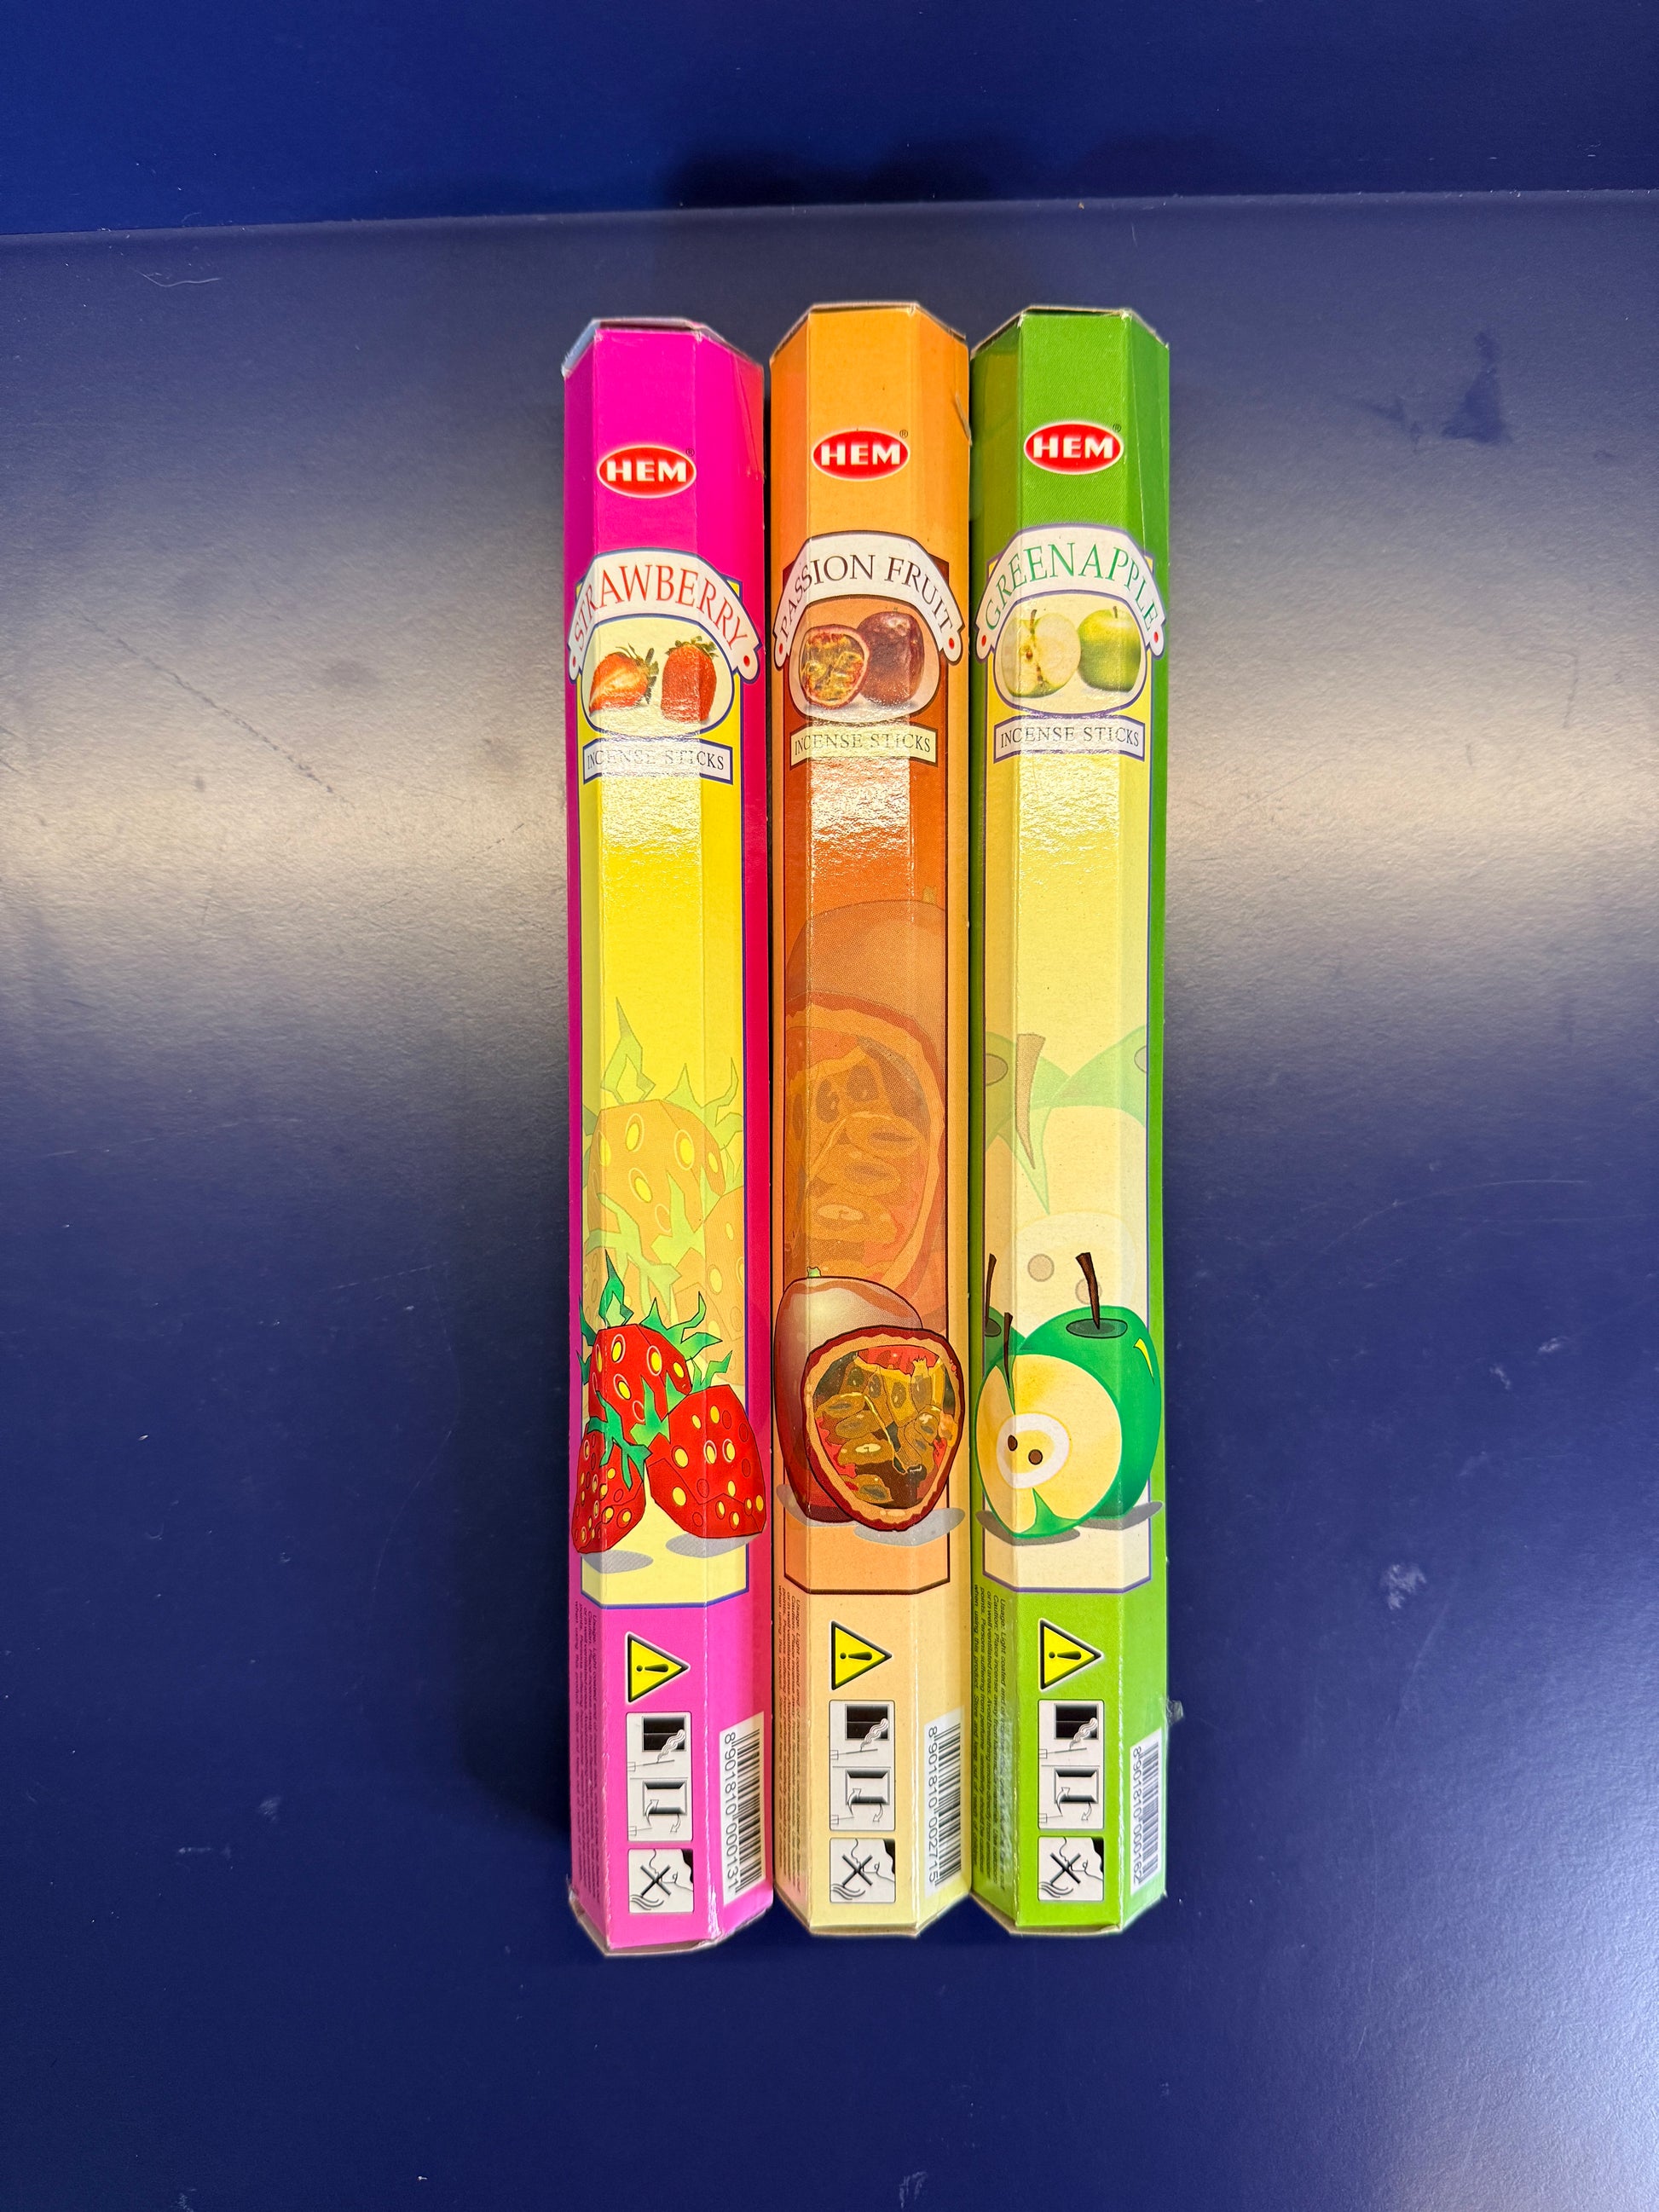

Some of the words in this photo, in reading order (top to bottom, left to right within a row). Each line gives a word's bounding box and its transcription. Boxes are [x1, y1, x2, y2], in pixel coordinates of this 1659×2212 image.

[820, 442, 901, 466] HEM
[1032, 436, 1114, 459] HEM
[606, 459, 687, 483] HEM
[778, 553, 876, 637] PASSION
[884, 556, 955, 632] FRUIT
[573, 563, 749, 653] STRAWBERRY
[794, 733, 863, 756] INCENSE
[869, 732, 931, 754] STICKS
[1000, 725, 1075, 749] INCENSE
[1082, 725, 1140, 747] STICKS
[587, 749, 656, 771] INCENSE
[663, 749, 725, 771] STICKS
[724, 1731, 737, 1746] 8
[928, 1724, 938, 1738] 8
